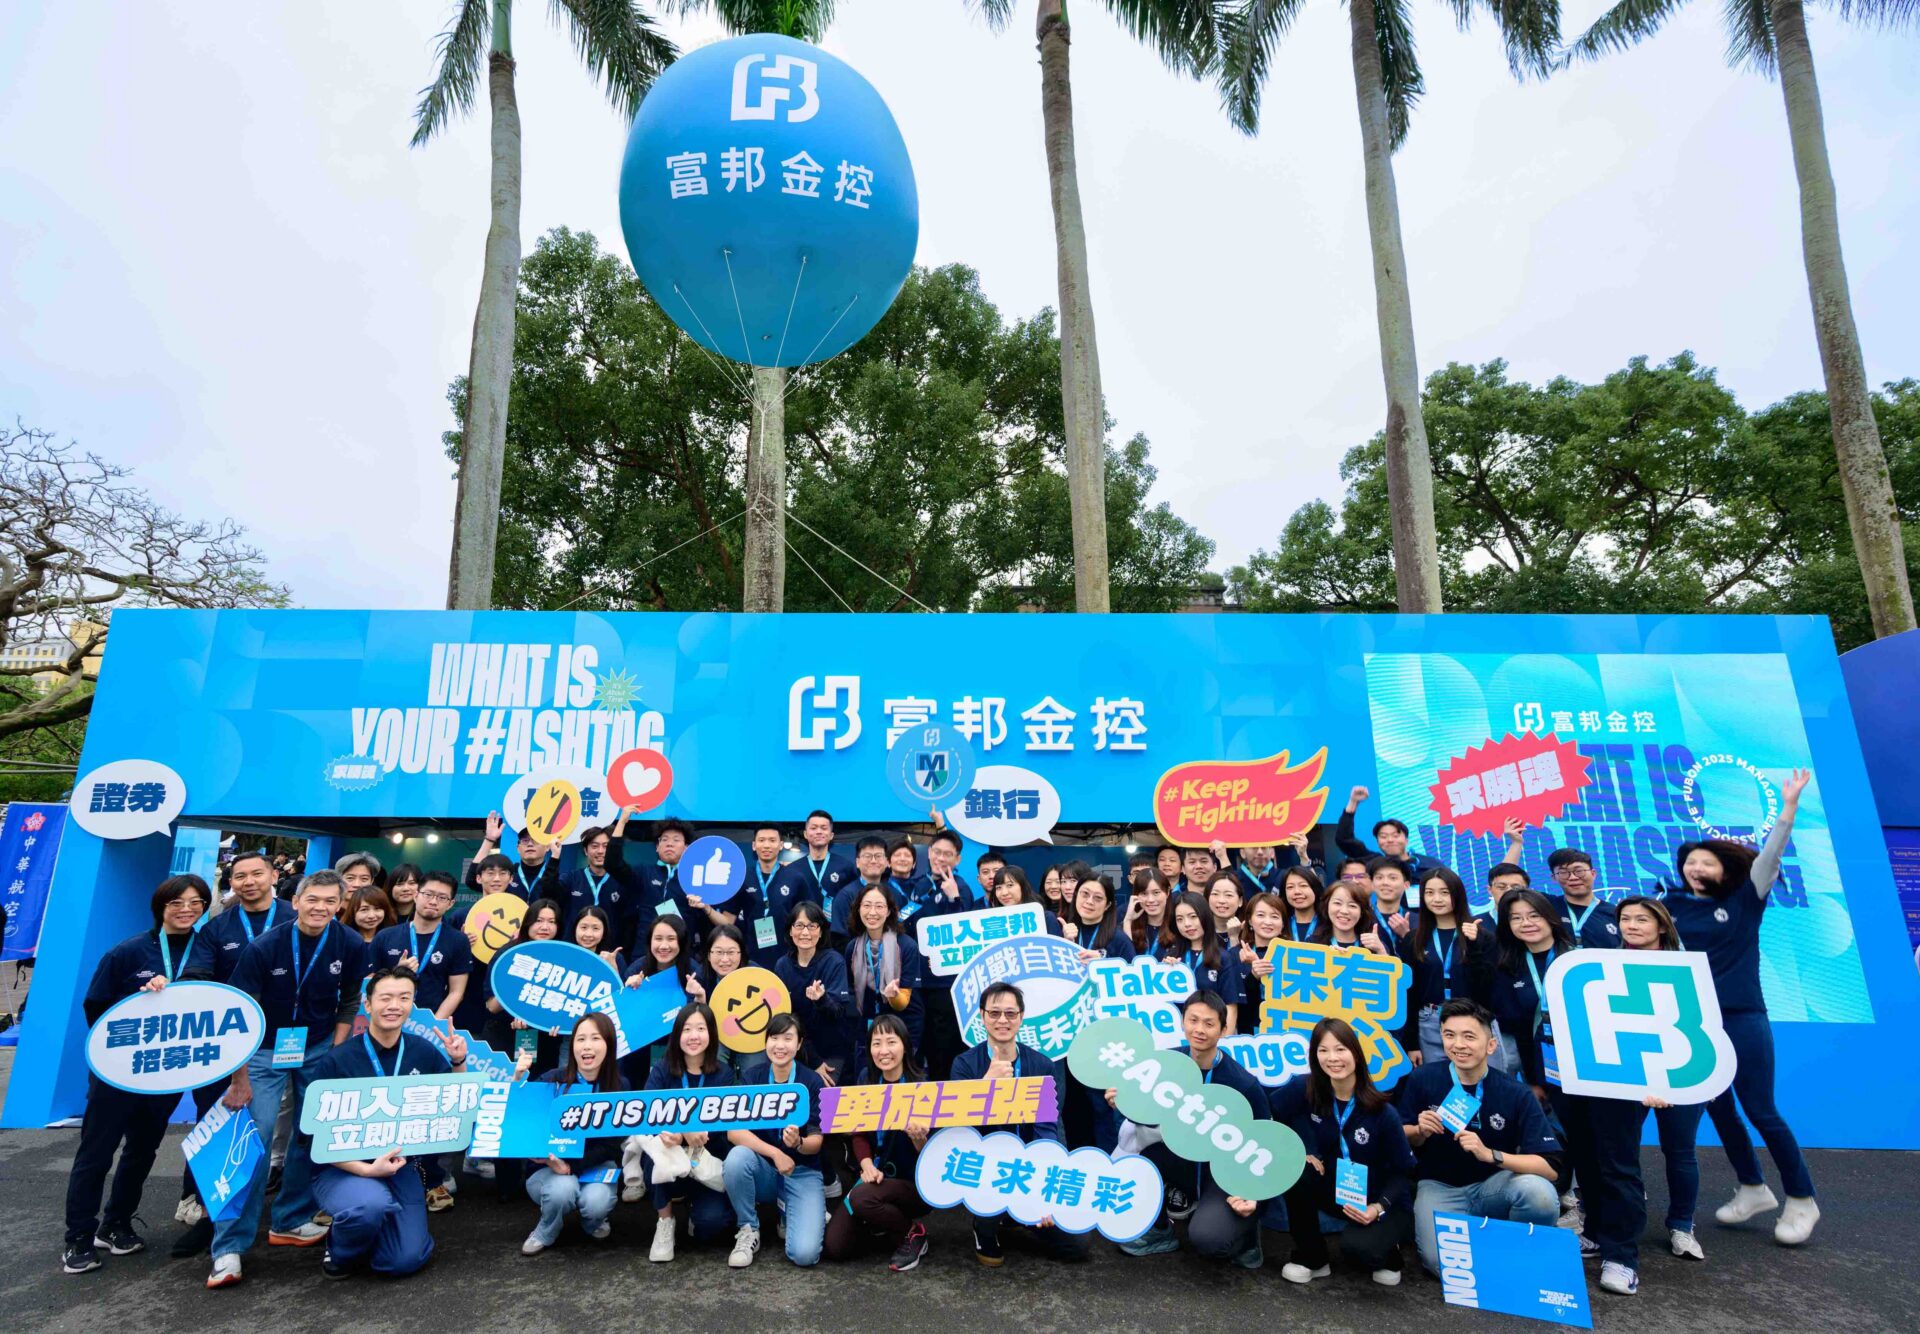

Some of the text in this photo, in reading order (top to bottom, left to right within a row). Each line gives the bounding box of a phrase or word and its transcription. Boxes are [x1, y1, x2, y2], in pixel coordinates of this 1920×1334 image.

[666, 147, 873, 209] 富邦金控
[427, 643, 598, 708] WHAT IS
[351, 708, 460, 774] YOUR
[884, 695, 1148, 751] 富邦金控
[1551, 710, 1657, 733] 富邦金控
[89, 782, 166, 812] 證券
[964, 788, 1040, 820] 銀行
[1178, 797, 1290, 833] Fighting
[1683, 761, 1703, 802] FUBON
[1702, 754, 1734, 767] 2025
[1736, 757, 1777, 839] MANAGEMENT
[926, 911, 1038, 947] 加入富邦
[507, 953, 613, 1001] 富邦MA
[1096, 964, 1189, 998] Take
[1271, 944, 1397, 1014] 保有
[518, 982, 588, 1019] 招募中
[106, 1007, 249, 1048] 富邦MA
[132, 1042, 221, 1075] 招募中
[314, 1080, 480, 1123] 加入富邦
[470, 1082, 511, 1157] FUBON
[560, 1092, 799, 1131] #IT IS MY BELIEF
[1099, 1041, 1273, 1177] #Action
[181, 1096, 236, 1161] UBON
[327, 1116, 462, 1152] 立即應徵
[941, 1147, 1137, 1216] 追求精彩
[1435, 1216, 1480, 1308] FUBON
